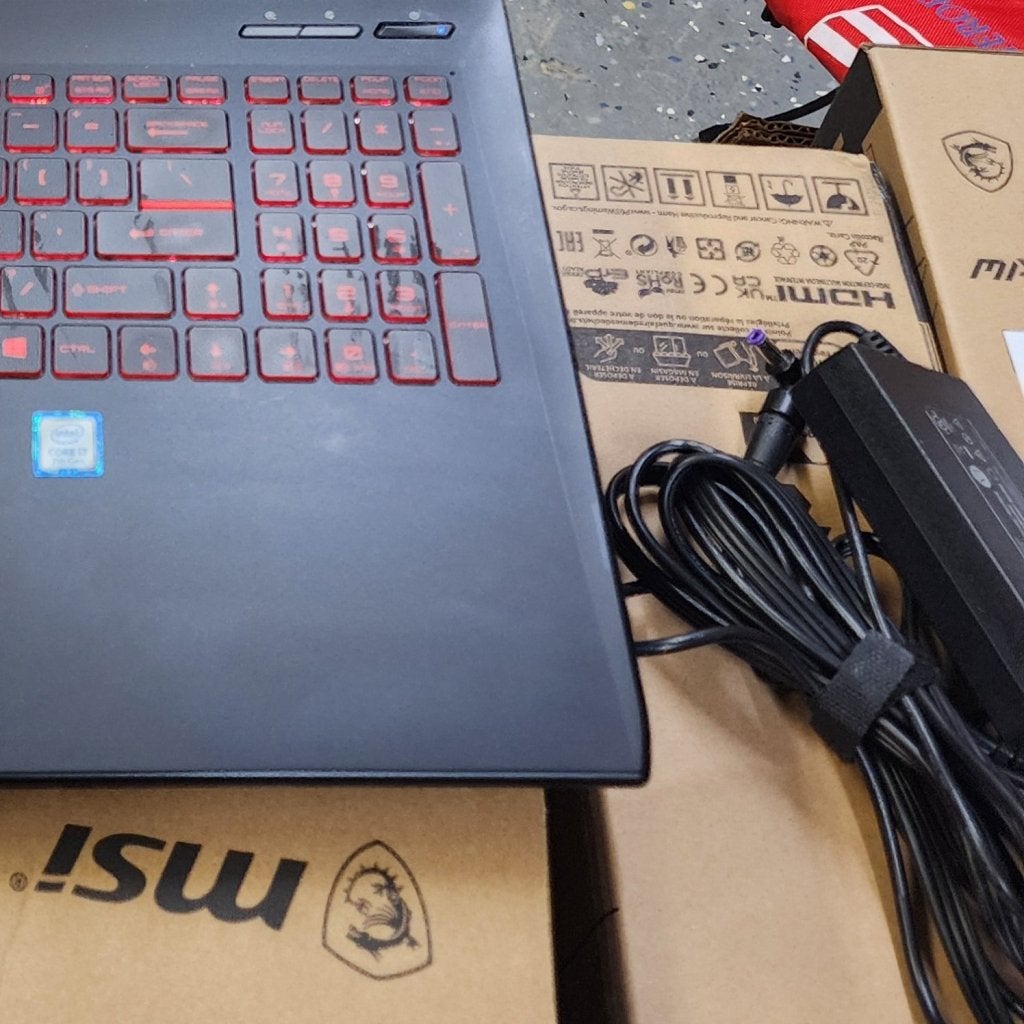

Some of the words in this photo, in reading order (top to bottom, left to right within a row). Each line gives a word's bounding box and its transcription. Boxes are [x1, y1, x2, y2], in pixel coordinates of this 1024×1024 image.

[635, 273, 684, 289] RoHS
[775, 284, 896, 310] HDMI
[59, 343, 97, 355] CTRL
[34, 823, 309, 931] msi
